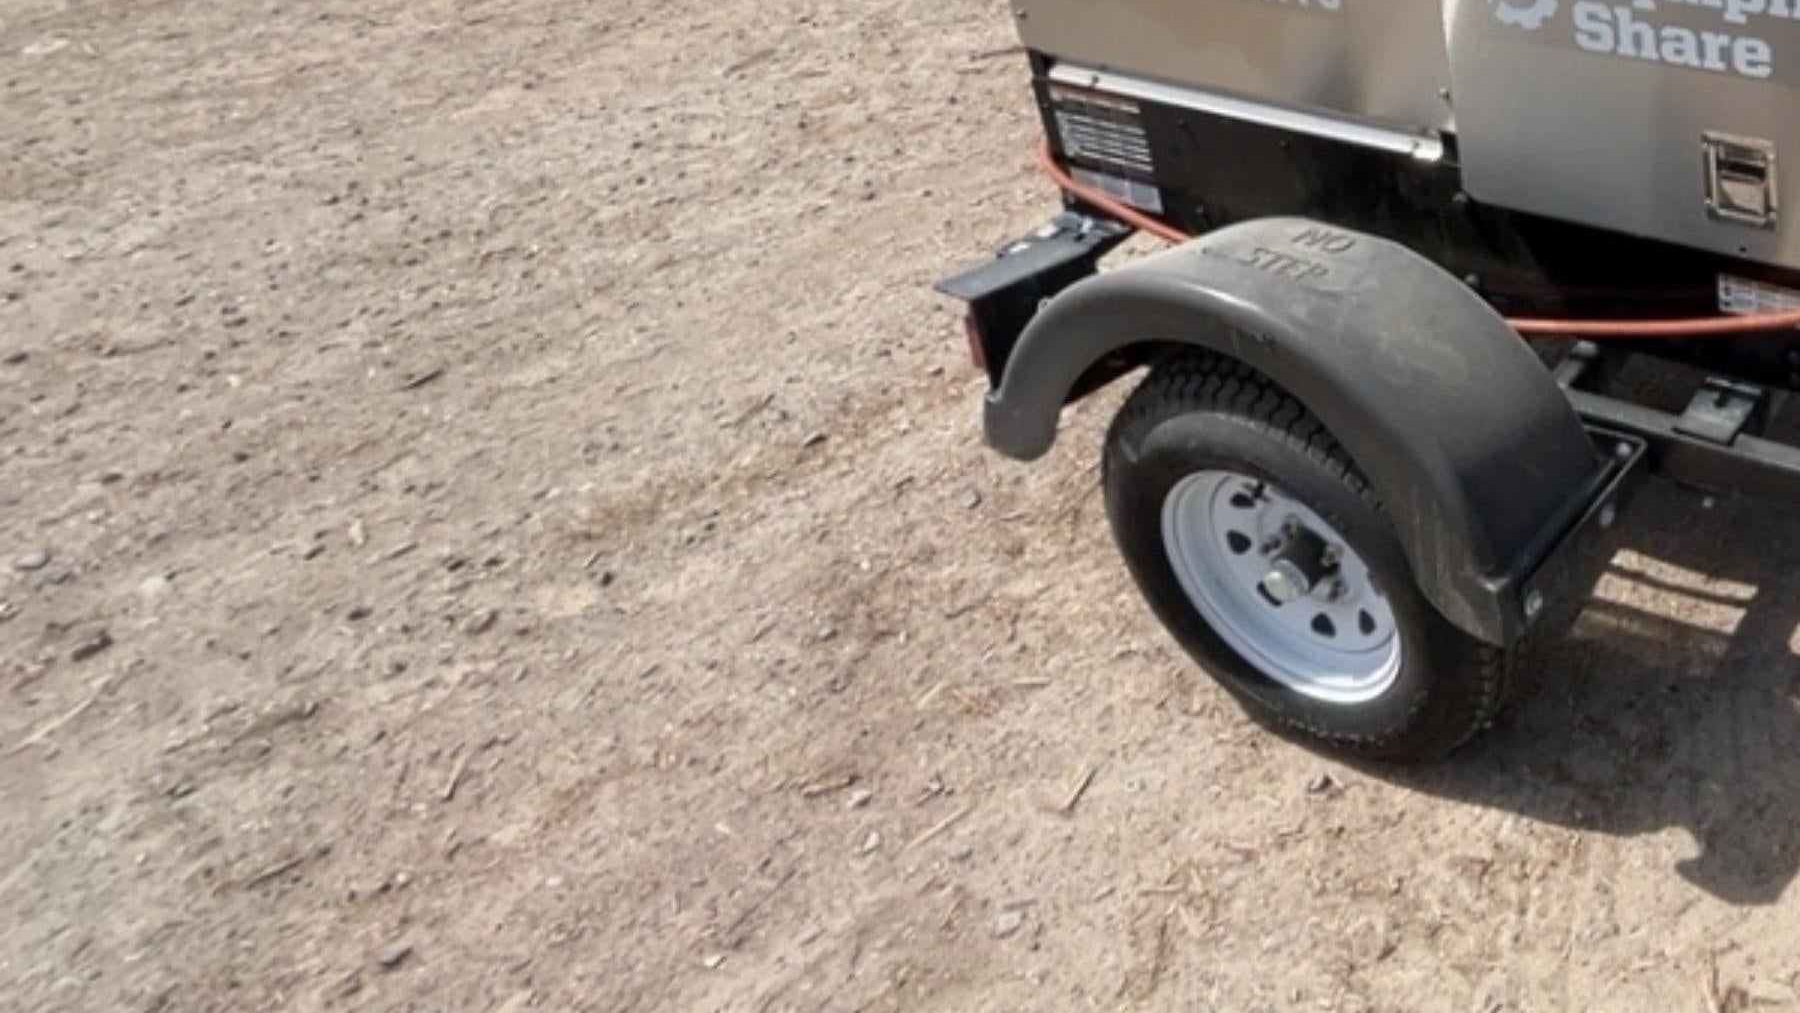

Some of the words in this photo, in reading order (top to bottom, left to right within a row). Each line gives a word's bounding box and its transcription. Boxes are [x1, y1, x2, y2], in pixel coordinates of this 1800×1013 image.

[1571, 0, 1774, 79] Share
[1291, 227, 1357, 255] NO
[1235, 246, 1330, 281] STEP
